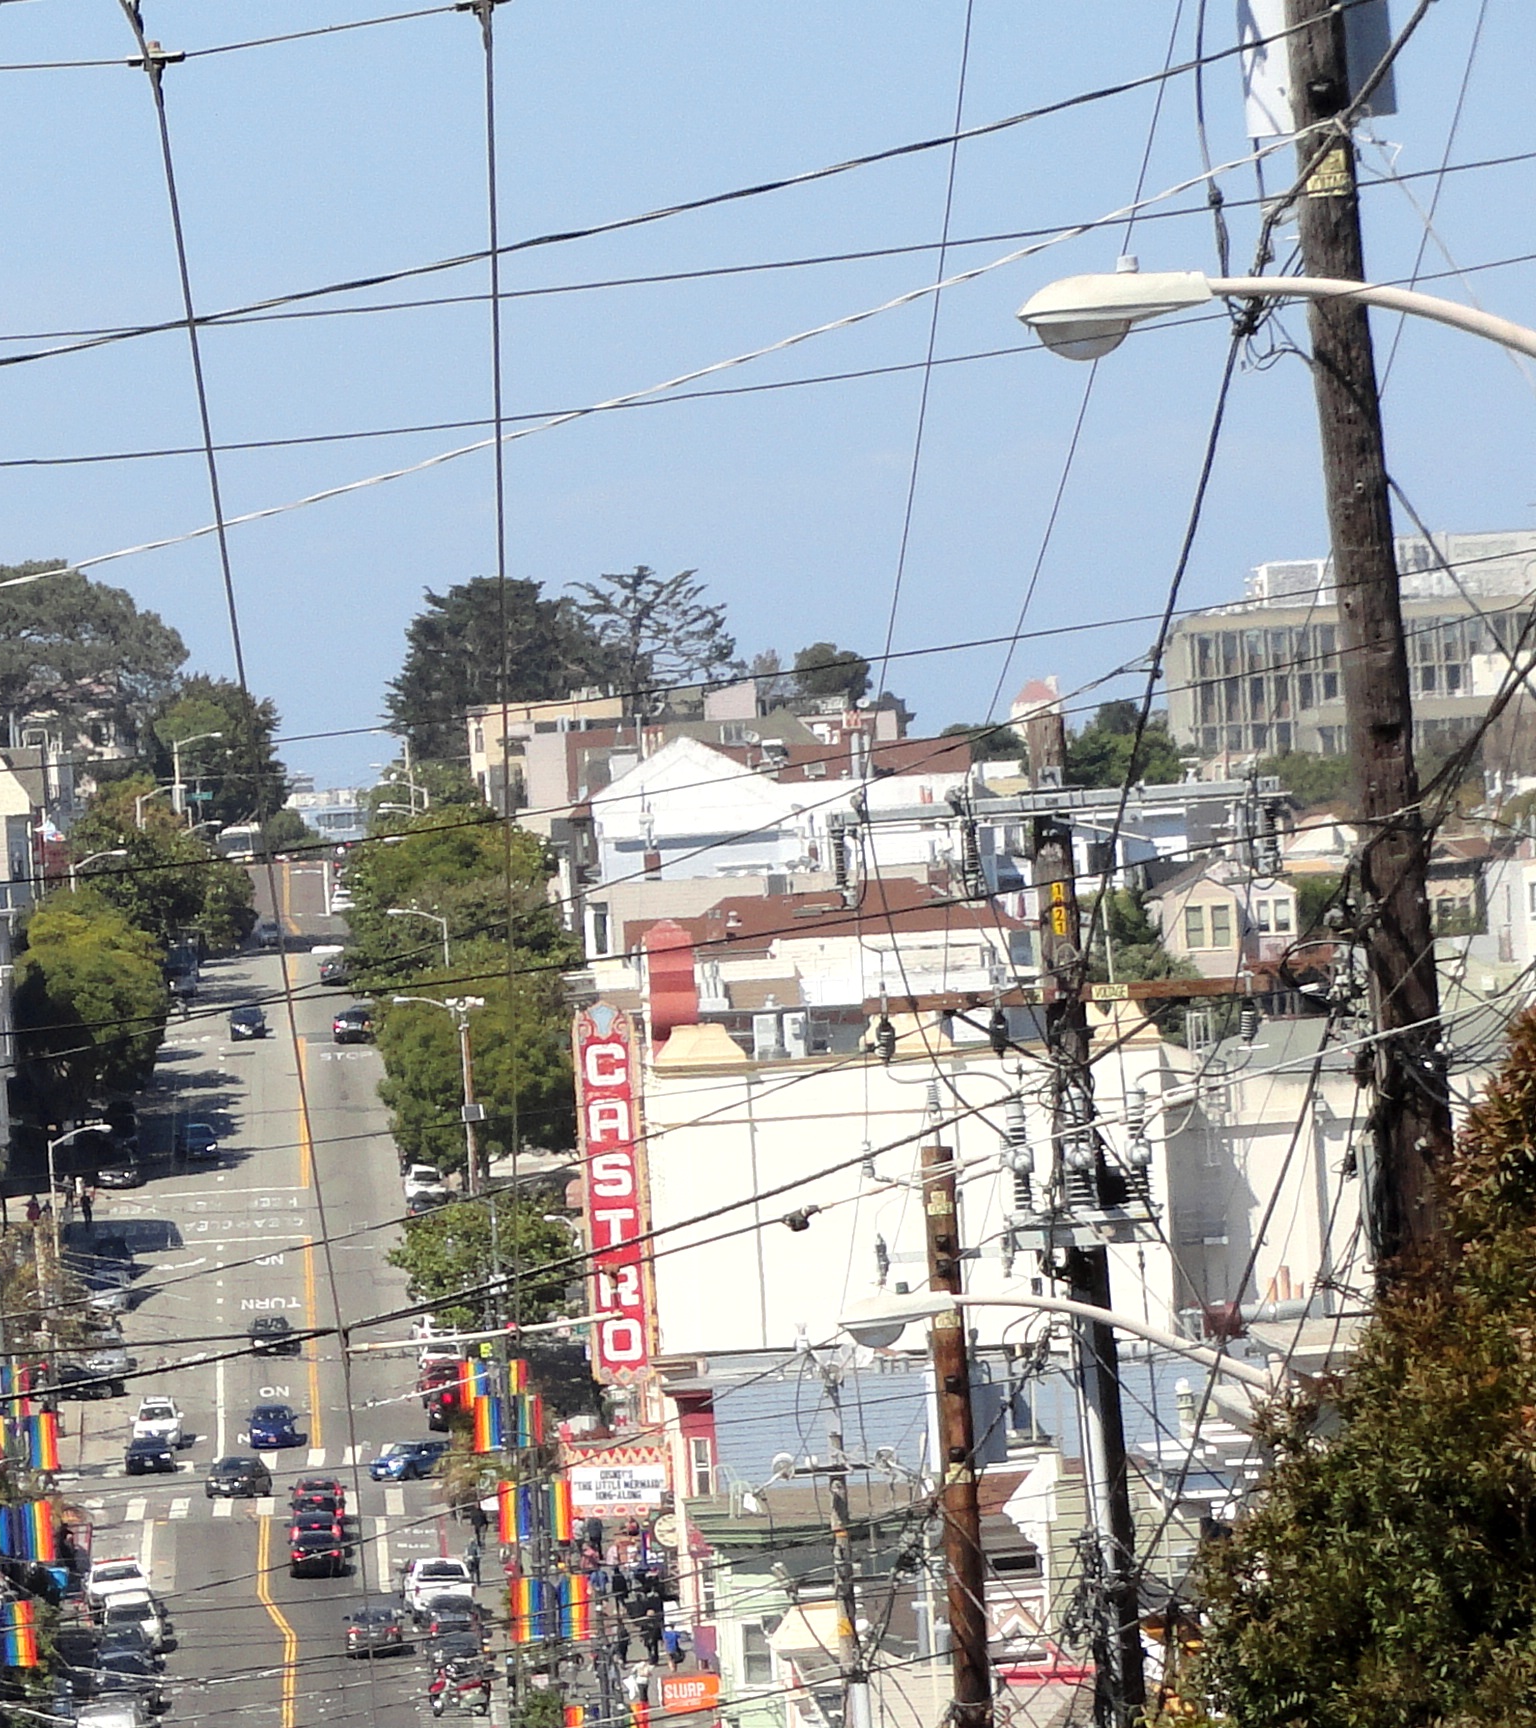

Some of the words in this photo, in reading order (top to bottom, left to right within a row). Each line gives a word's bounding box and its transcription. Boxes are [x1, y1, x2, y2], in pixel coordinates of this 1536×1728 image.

[320, 1051, 373, 1061] STOP
[584, 1042, 644, 1361] CASTRO
[240, 1296, 303, 1310] TURN
[258, 1385, 291, 1397] NO
[663, 1682, 706, 1699] SLURP
